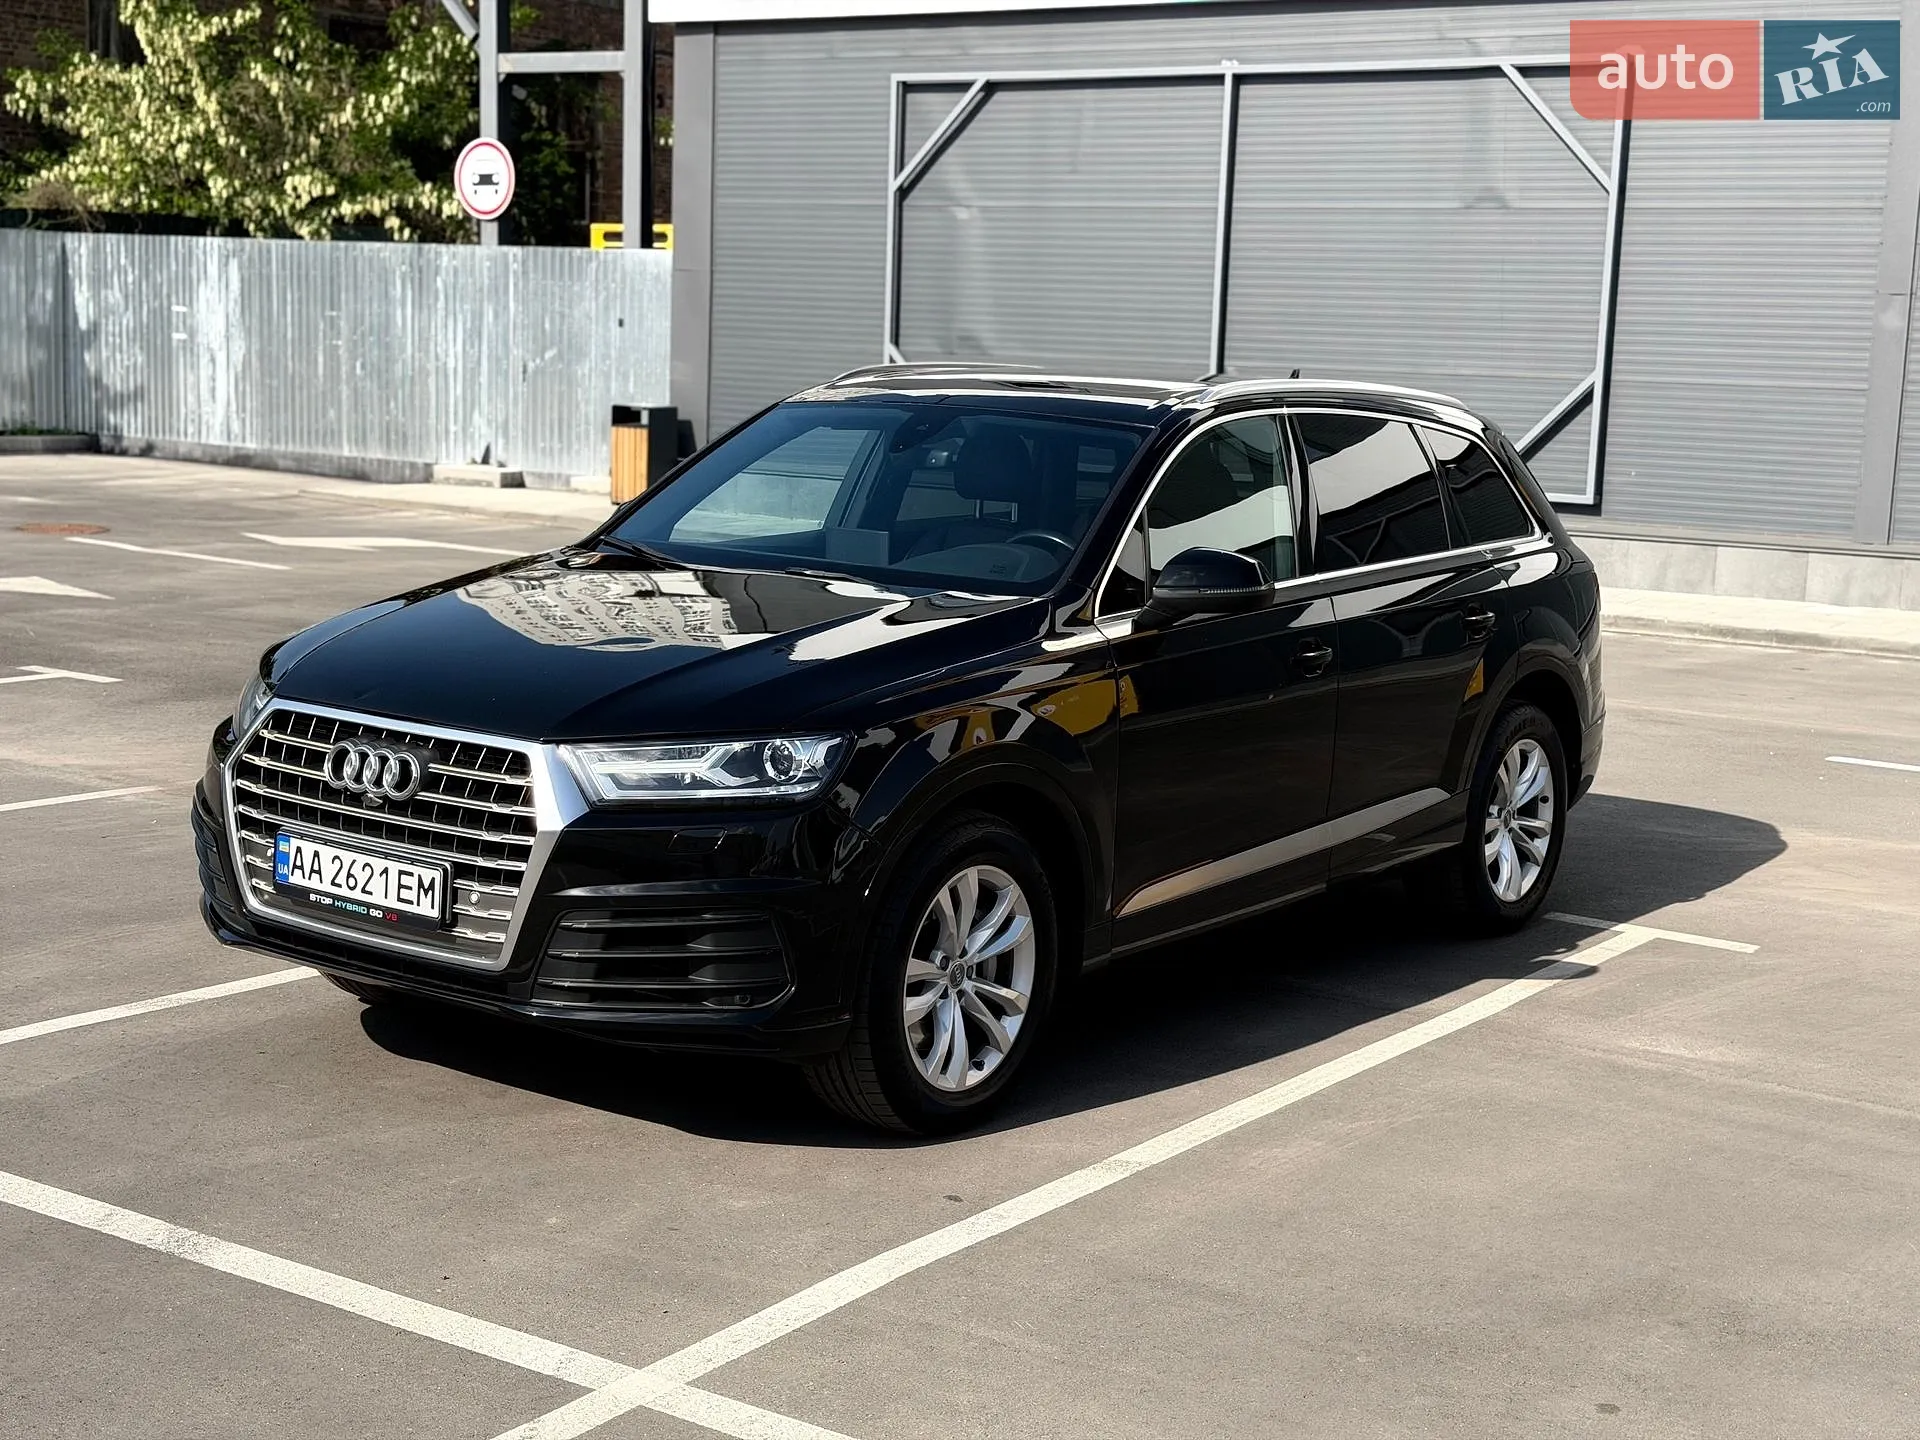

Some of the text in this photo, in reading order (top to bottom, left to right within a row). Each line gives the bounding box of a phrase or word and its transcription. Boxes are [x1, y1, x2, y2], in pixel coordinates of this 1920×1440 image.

[277, 862, 289, 876] UA
[290, 845, 436, 910] AA 2621 EM
[309, 893, 333, 905] STOP
[334, 899, 368, 914] HYBRID
[369, 908, 383, 918] GO
